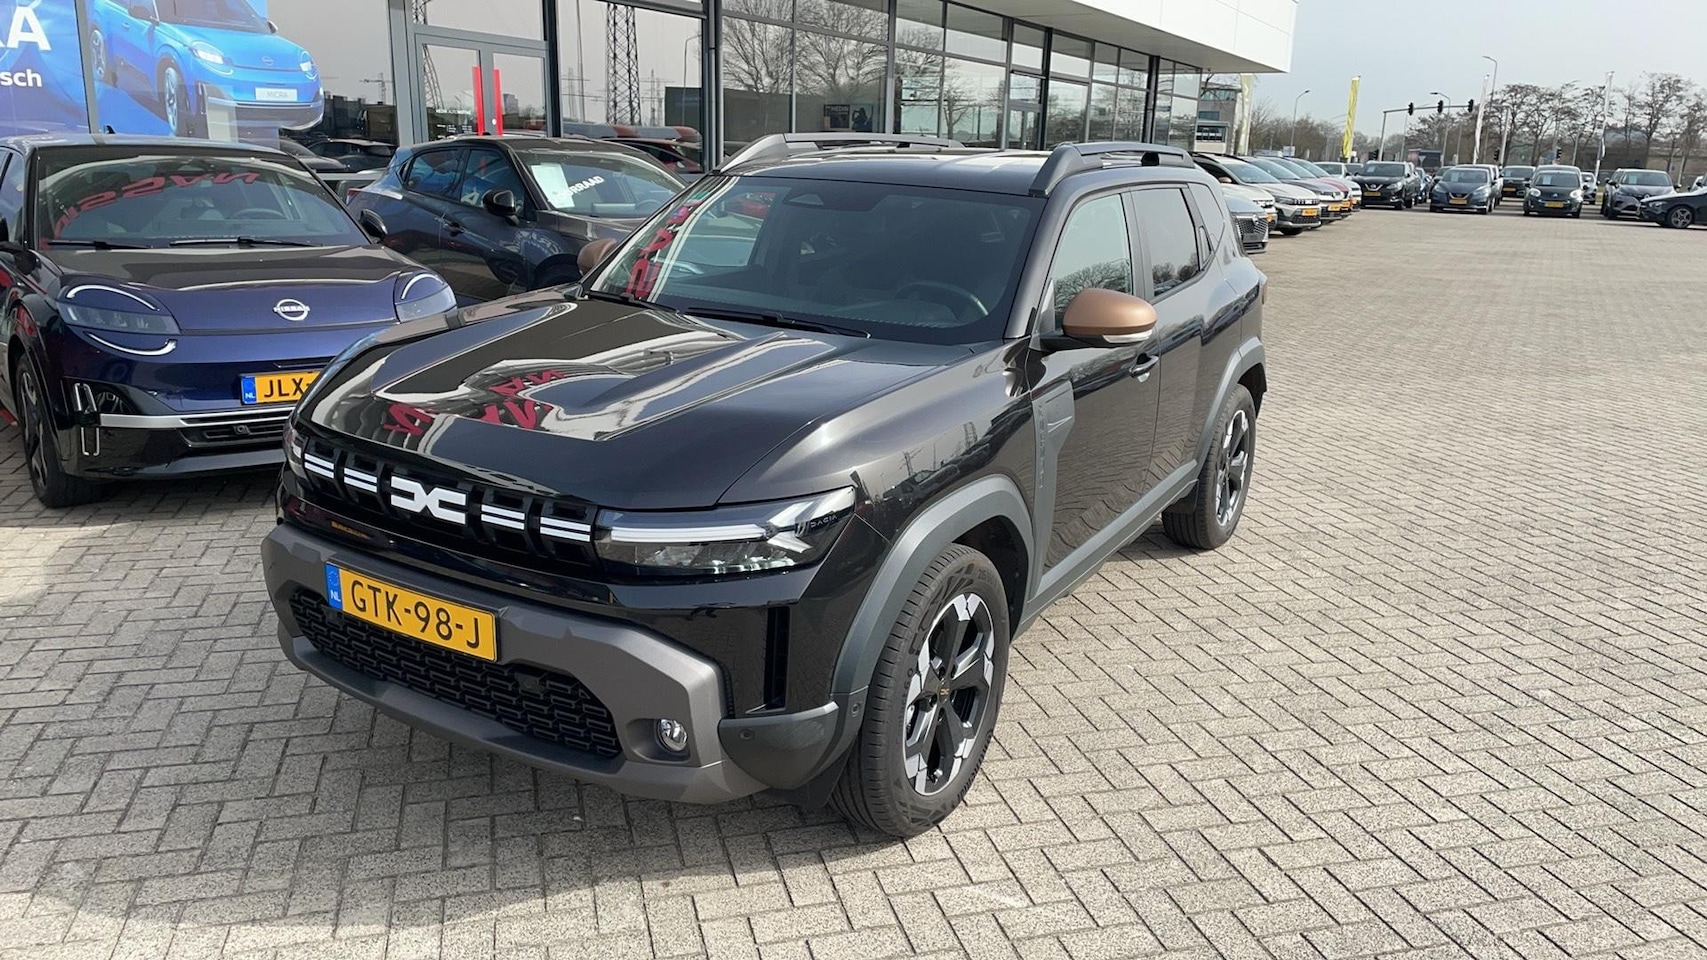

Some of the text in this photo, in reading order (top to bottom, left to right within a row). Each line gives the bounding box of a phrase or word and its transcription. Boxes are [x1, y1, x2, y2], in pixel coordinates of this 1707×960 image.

[0, 6, 52, 51] A
[330, 589, 341, 602] NL
[351, 579, 480, 649] GTK-98-J
